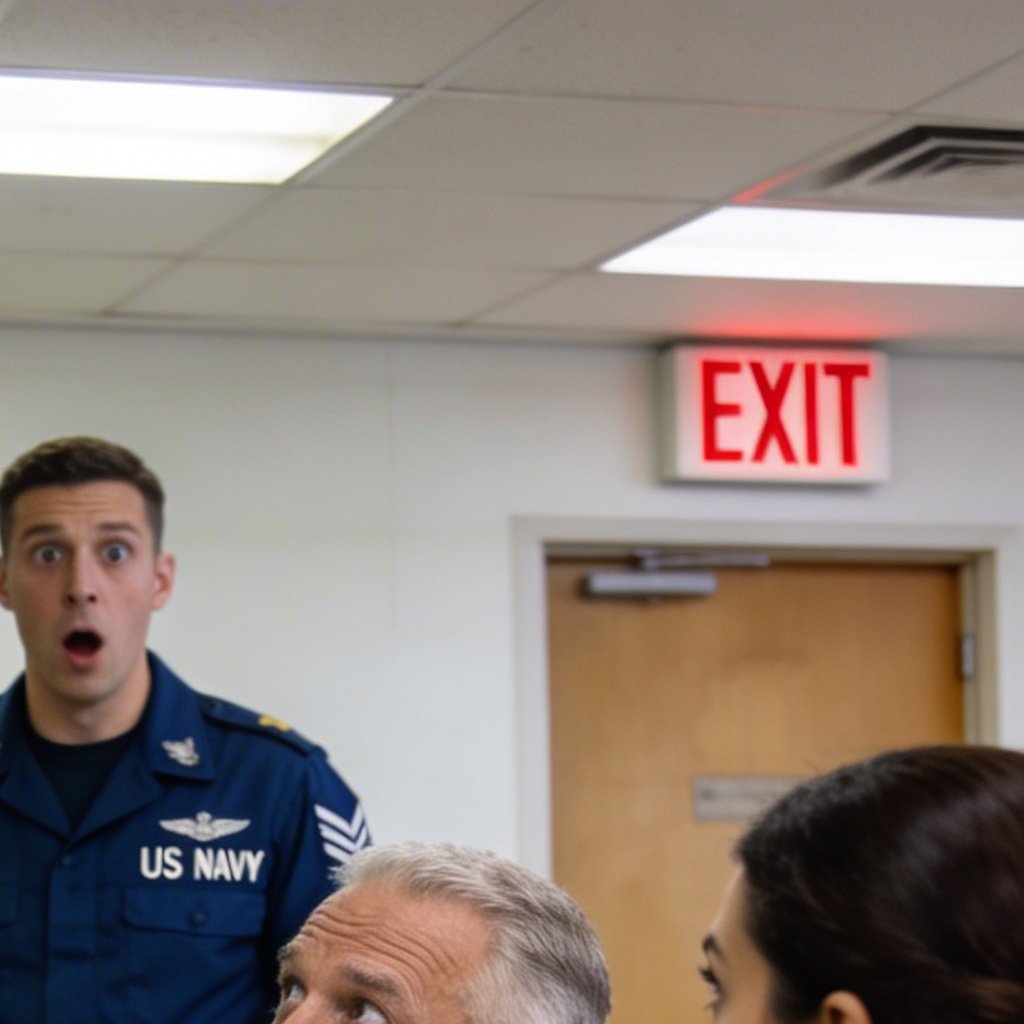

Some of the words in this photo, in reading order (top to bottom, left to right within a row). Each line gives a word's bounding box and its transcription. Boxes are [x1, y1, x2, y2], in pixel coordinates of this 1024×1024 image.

[701, 360, 870, 467] EXIT
[139, 845, 184, 880] US
[193, 847, 266, 883] NAVY
